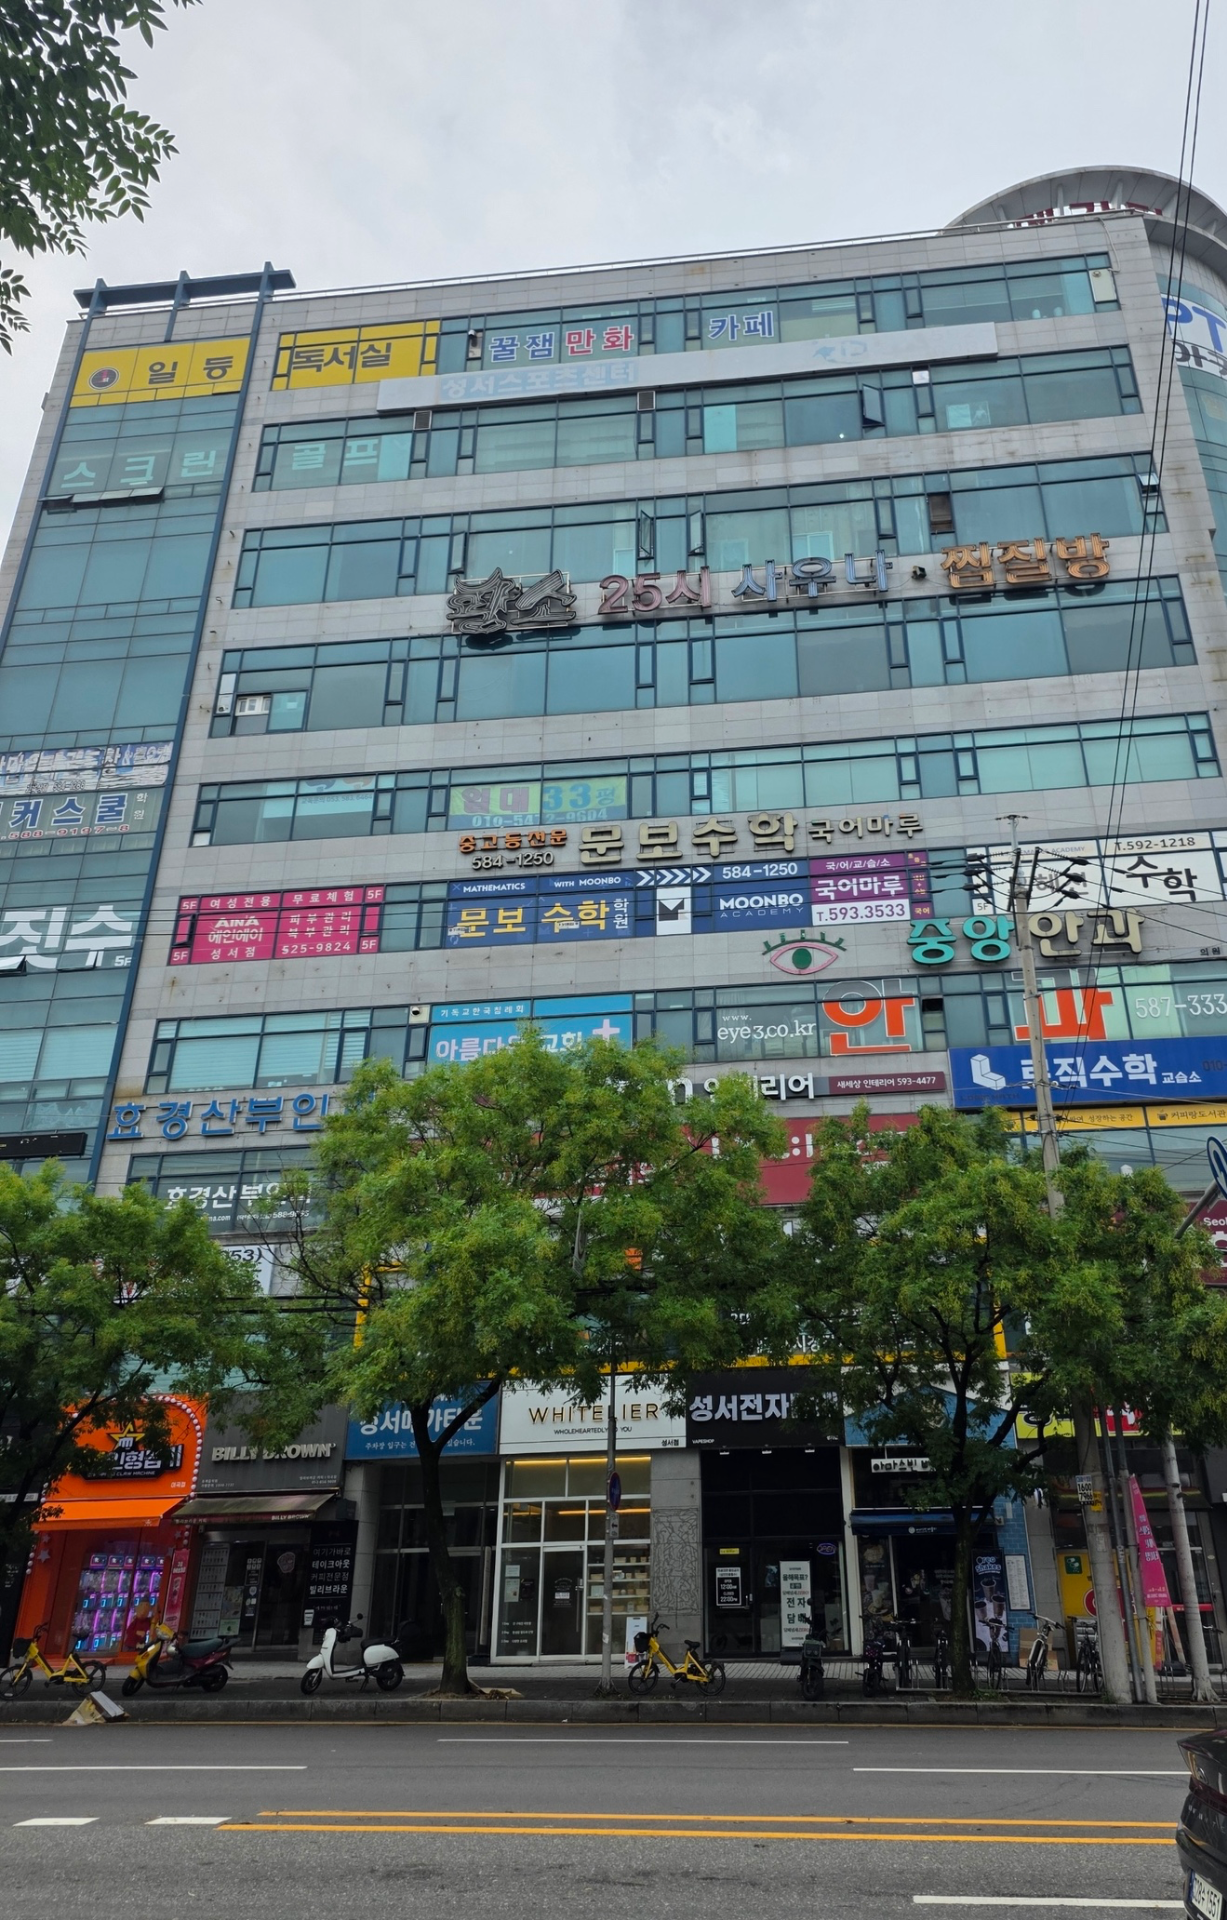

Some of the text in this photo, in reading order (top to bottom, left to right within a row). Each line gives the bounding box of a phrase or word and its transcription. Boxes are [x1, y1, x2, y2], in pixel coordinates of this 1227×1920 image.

[706, 310, 775, 341] 카페
[1161, 297, 1227, 353] PT
[488, 325, 635, 363] 꿀잼 만화
[292, 342, 393, 373] 독서실
[147, 354, 235, 386] 일등
[441, 361, 638, 400] 성서스포츠센터
[292, 438, 380, 471] 골프
[60, 449, 216, 490] 스크린
[731, 548, 893, 601] 사우나
[941, 532, 1111, 589] 찜질방
[460, 786, 530, 815] 임대
[0, 792, 128, 830] 커스쿨
[458, 829, 568, 854] 중고등전문
[578, 811, 924, 867] 문보수학 국어마루
[1115, 836, 1196, 852] T.592-1218
[471, 852, 554, 871] 584-1250
[721, 861, 798, 880] 584-1250
[825, 857, 891, 871] 국/어/교/습/소
[463, 876, 621, 893] MATHEMATICS WITH MOONBO
[814, 875, 904, 901] 국어마루
[1126, 856, 1197, 903] 수학
[210, 896, 271, 909] 여성전용
[292, 890, 354, 905] 무료체험
[367, 890, 382, 899] 5F
[719, 893, 803, 911] MOONBO
[182, 901, 197, 910] 5F
[613, 898, 629, 930] 학원
[720, 906, 804, 919] ACADEMY
[815, 903, 906, 923] T.593.3533
[977, 902, 989, 911] 5F
[289, 911, 352, 925] 피부관리
[457, 899, 610, 938] 문보 수학
[361, 940, 377, 950] 5F
[906, 906, 1145, 965] 중앙 안과
[173, 951, 189, 961] 5F
[210, 946, 256, 960] 성서점
[281, 941, 351, 955] 525-9824
[1200, 946, 1221, 957] 의원
[114, 955, 133, 967] 5F
[440, 1004, 525, 1018] 기독교한국침례회
[703, 1072, 814, 1102] 리어
[836, 1076, 937, 1089] 새세상 인테리어 593-4477
[1162, 1071, 1203, 1084] 교습소
[106, 1093, 376, 1141] 효경산부인
[163, 1182, 316, 1210] 효경산부
[528, 1402, 660, 1425] WHITEIER
[211, 1442, 333, 1462] BILLY BROWN
[1077, 1482, 1092, 1492] 1600
[311, 1558, 350, 1570] 테이크아웃
[310, 1571, 350, 1582] 커피전문점
[309, 1583, 349, 1595] 빌리브라운
[786, 1597, 807, 1609] 전자
